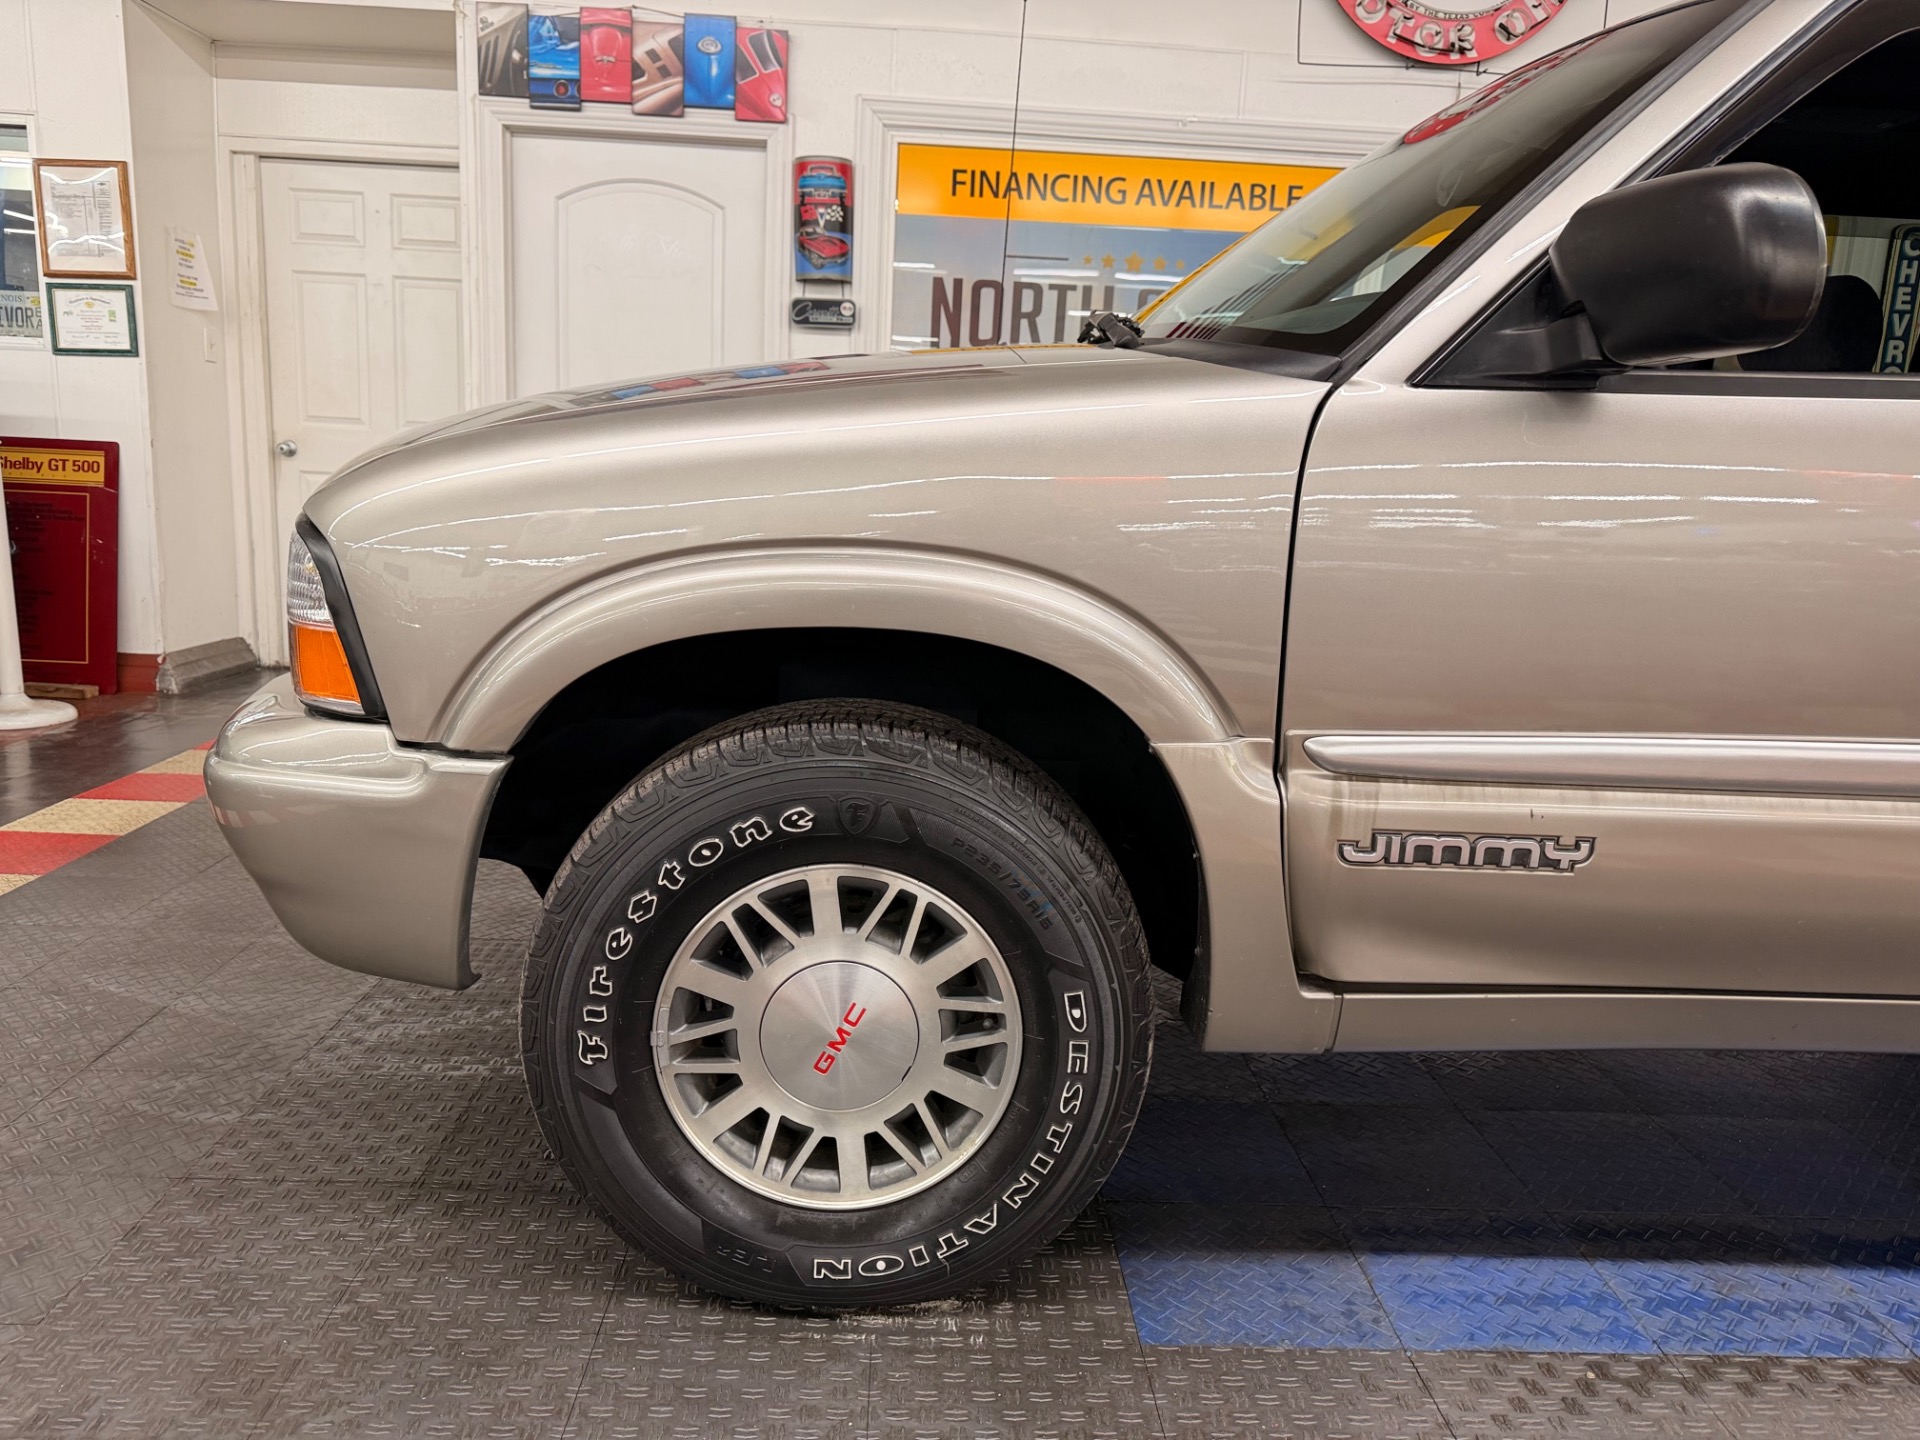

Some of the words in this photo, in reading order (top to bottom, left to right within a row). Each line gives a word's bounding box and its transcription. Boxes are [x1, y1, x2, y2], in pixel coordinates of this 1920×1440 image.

[1423, 8, 1440, 18] THE
[1443, 12, 1470, 20] TEXAS
[951, 169, 1127, 205] FINANCING
[1134, 178, 1304, 212] AVAILABLE
[930, 276, 1115, 349] NORTH
[48, 458, 70, 472] GT
[72, 459, 100, 474] 500
[577, 806, 815, 1066] Firestone
[813, 1002, 867, 1075] GMC
[813, 989, 1091, 1280] DESTINATION
